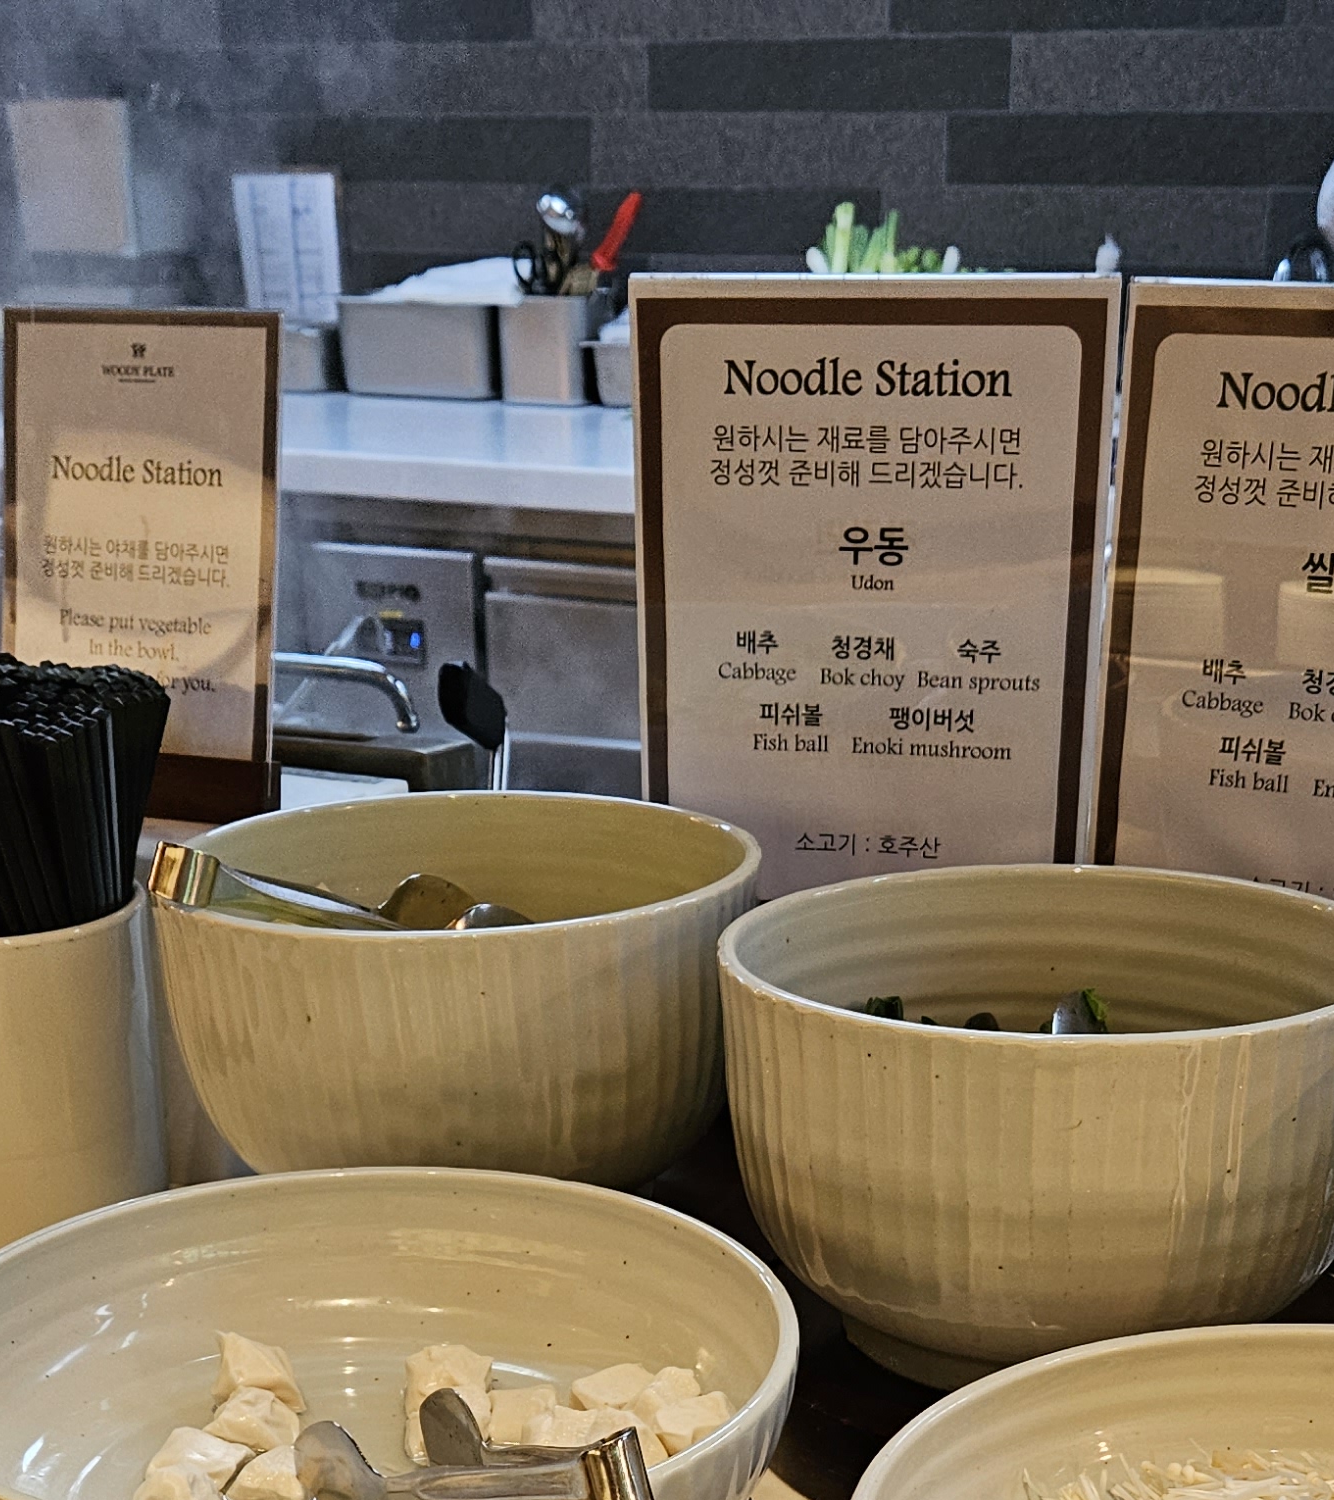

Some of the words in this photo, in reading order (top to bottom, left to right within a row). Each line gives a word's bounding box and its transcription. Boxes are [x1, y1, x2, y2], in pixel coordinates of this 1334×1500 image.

[101, 364, 141, 377] WOODY
[142, 365, 175, 378] PLATE
[723, 356, 863, 397] Noodle
[875, 358, 1013, 398] Station
[712, 424, 809, 453] 원하시는
[817, 425, 891, 454] 재료를
[899, 425, 1021, 456] 담아주시면
[1200, 439, 1302, 471] 원하시는
[52, 455, 135, 483] Noodle
[142, 459, 223, 487] Station
[710, 458, 781, 487] 정성껏
[788, 459, 860, 488] 준비해
[868, 460, 1024, 490] 드리겠습니다.
[1194, 475, 1266, 506] 정성껏
[43, 535, 102, 557] 원하시는
[106, 538, 149, 561] 야채를
[154, 540, 229, 565] 담아주시면
[838, 526, 909, 567] 우동
[41, 558, 85, 579] 정성껏
[90, 561, 134, 583] 준비해
[137, 565, 230, 588] 드리겠습니다.
[851, 574, 895, 592] Udon
[60, 608, 105, 628] Please
[109, 614, 135, 635] put
[139, 615, 212, 638] vegetable
[108, 639, 133, 658] the
[137, 641, 180, 662] bowl.
[736, 630, 779, 655] 배추
[831, 635, 896, 661] 청경채
[956, 638, 1002, 664] 숙주
[718, 661, 797, 685] Cabbage
[820, 667, 855, 686] Bok
[860, 668, 905, 691] choy
[917, 670, 963, 690] Bean
[968, 673, 1040, 694] sprouts
[1202, 658, 1247, 685] 배추
[181, 676, 216, 695] you.
[759, 702, 823, 727] 피쉬볼
[1182, 689, 1264, 718] Cabbage
[1288, 702, 1326, 723] Bok
[889, 706, 975, 733] 팽이버섯
[753, 733, 788, 752] Fish
[794, 734, 829, 753] ball
[851, 737, 903, 756] Enoki
[909, 741, 1012, 761] mushroom
[1219, 735, 1286, 766] 피쉬볼
[1208, 768, 1246, 789] Fish
[1252, 773, 1289, 794] ball
[795, 832, 856, 856] 소고기
[878, 834, 941, 859] 호주산
